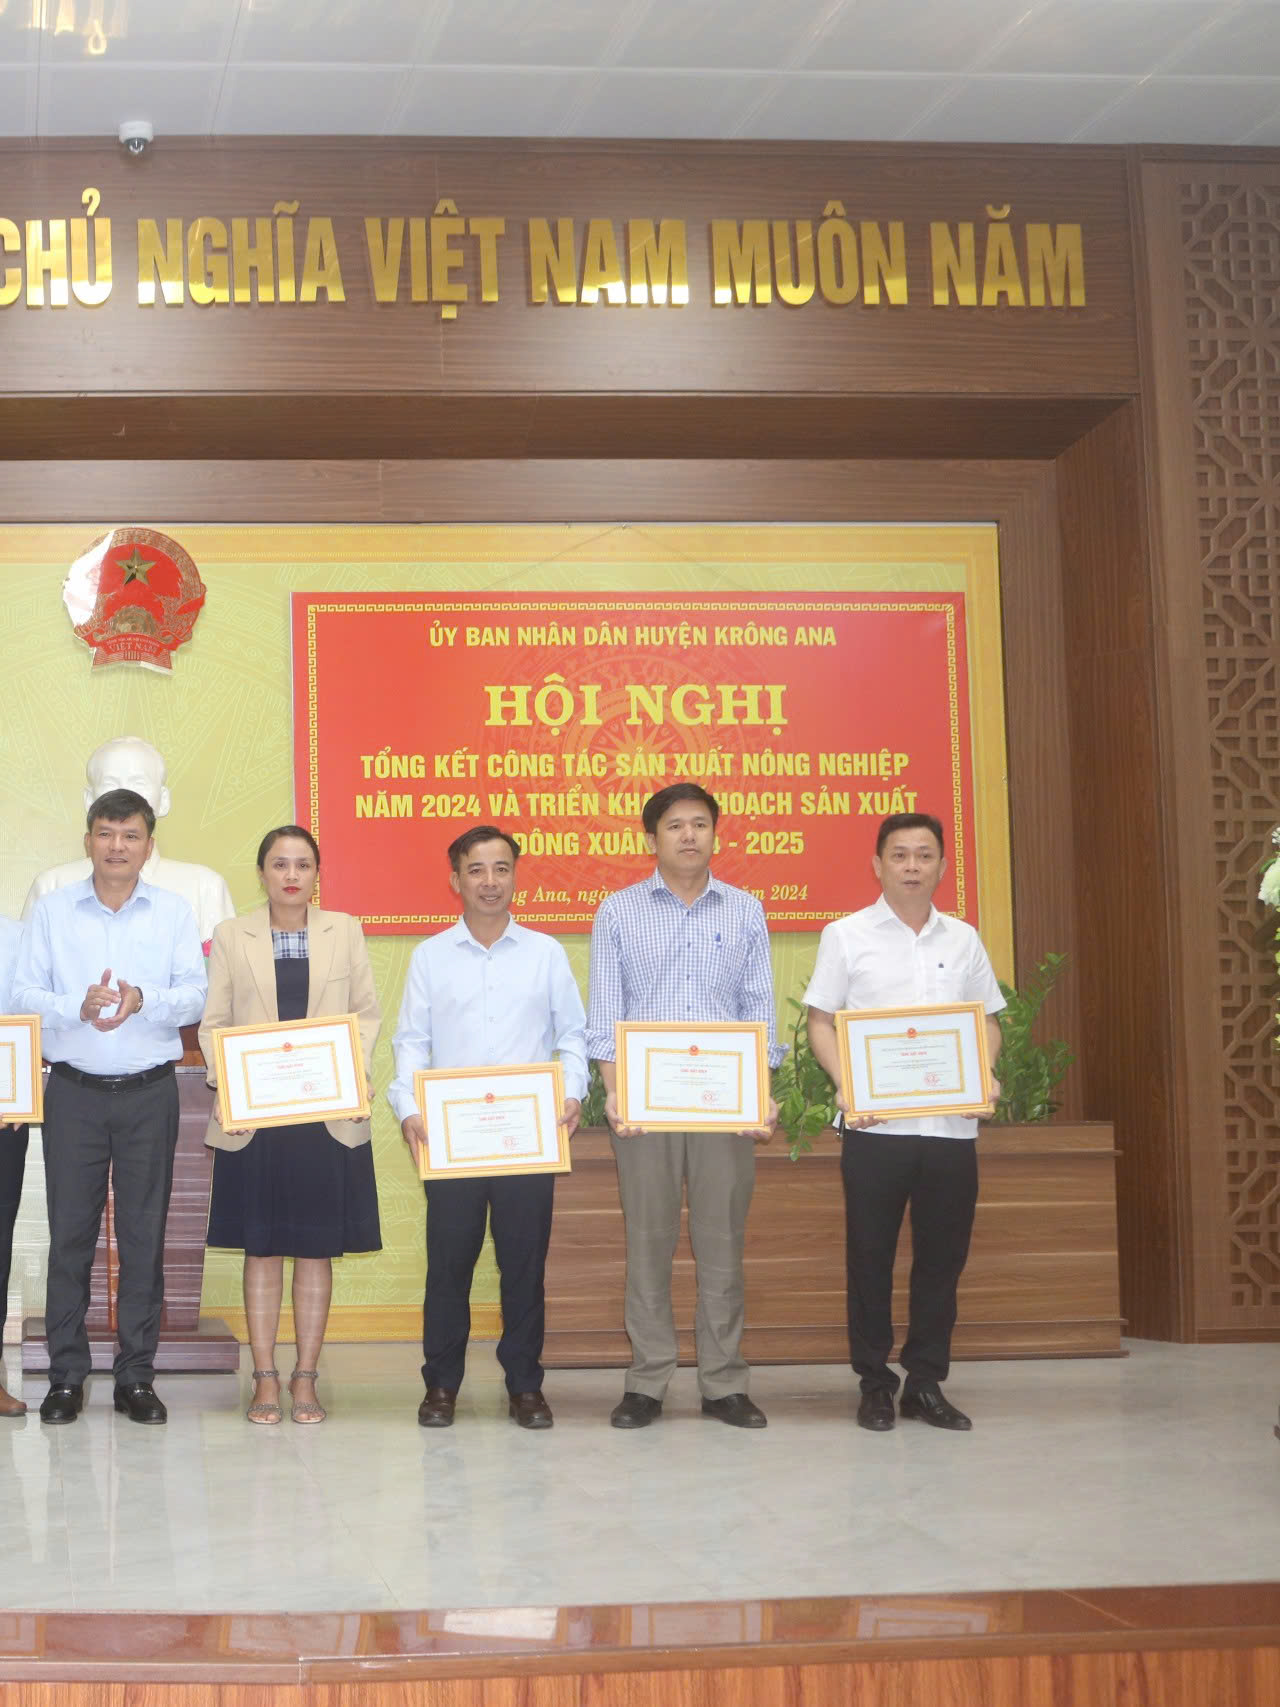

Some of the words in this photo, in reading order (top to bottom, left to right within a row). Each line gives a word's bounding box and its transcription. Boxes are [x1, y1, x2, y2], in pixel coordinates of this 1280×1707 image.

[136, 201, 346, 306] NGHĨA
[364, 199, 506, 319] VIỆT
[528, 217, 689, 306] NAM
[711, 200, 908, 306] MUÔN
[930, 204, 1087, 307] NĂM
[429, 619, 458, 647] ỦY
[465, 626, 510, 647] BAN
[517, 621, 577, 646] NHÂN
[583, 620, 628, 646] DÂN
[634, 620, 708, 649] HUYỆN
[714, 620, 788, 646] KRÔNG
[794, 626, 837, 646] ANA
[484, 672, 604, 737] HỘI
[624, 684, 789, 737] NGHỊ
[360, 746, 426, 779] TỔNG
[434, 746, 480, 778] KẾT
[487, 750, 555, 778] CÔNG
[562, 749, 608, 777] TÁC
[615, 747, 666, 777] SẢN
[673, 745, 735, 777] XUẤT
[742, 748, 811, 777] NÔNG
[818, 748, 910, 781] NGHIỆP
[355, 790, 413, 818] NĂM
[421, 794, 482, 818] 2024
[488, 788, 521, 817] VÀ
[526, 783, 600, 816] TRIỂN
[800, 784, 851, 815] SẢN
[857, 784, 918, 815] XUẤT
[745, 831, 805, 855] 2025
[532, 885, 571, 905] Ana,
[770, 884, 808, 901] 2024
